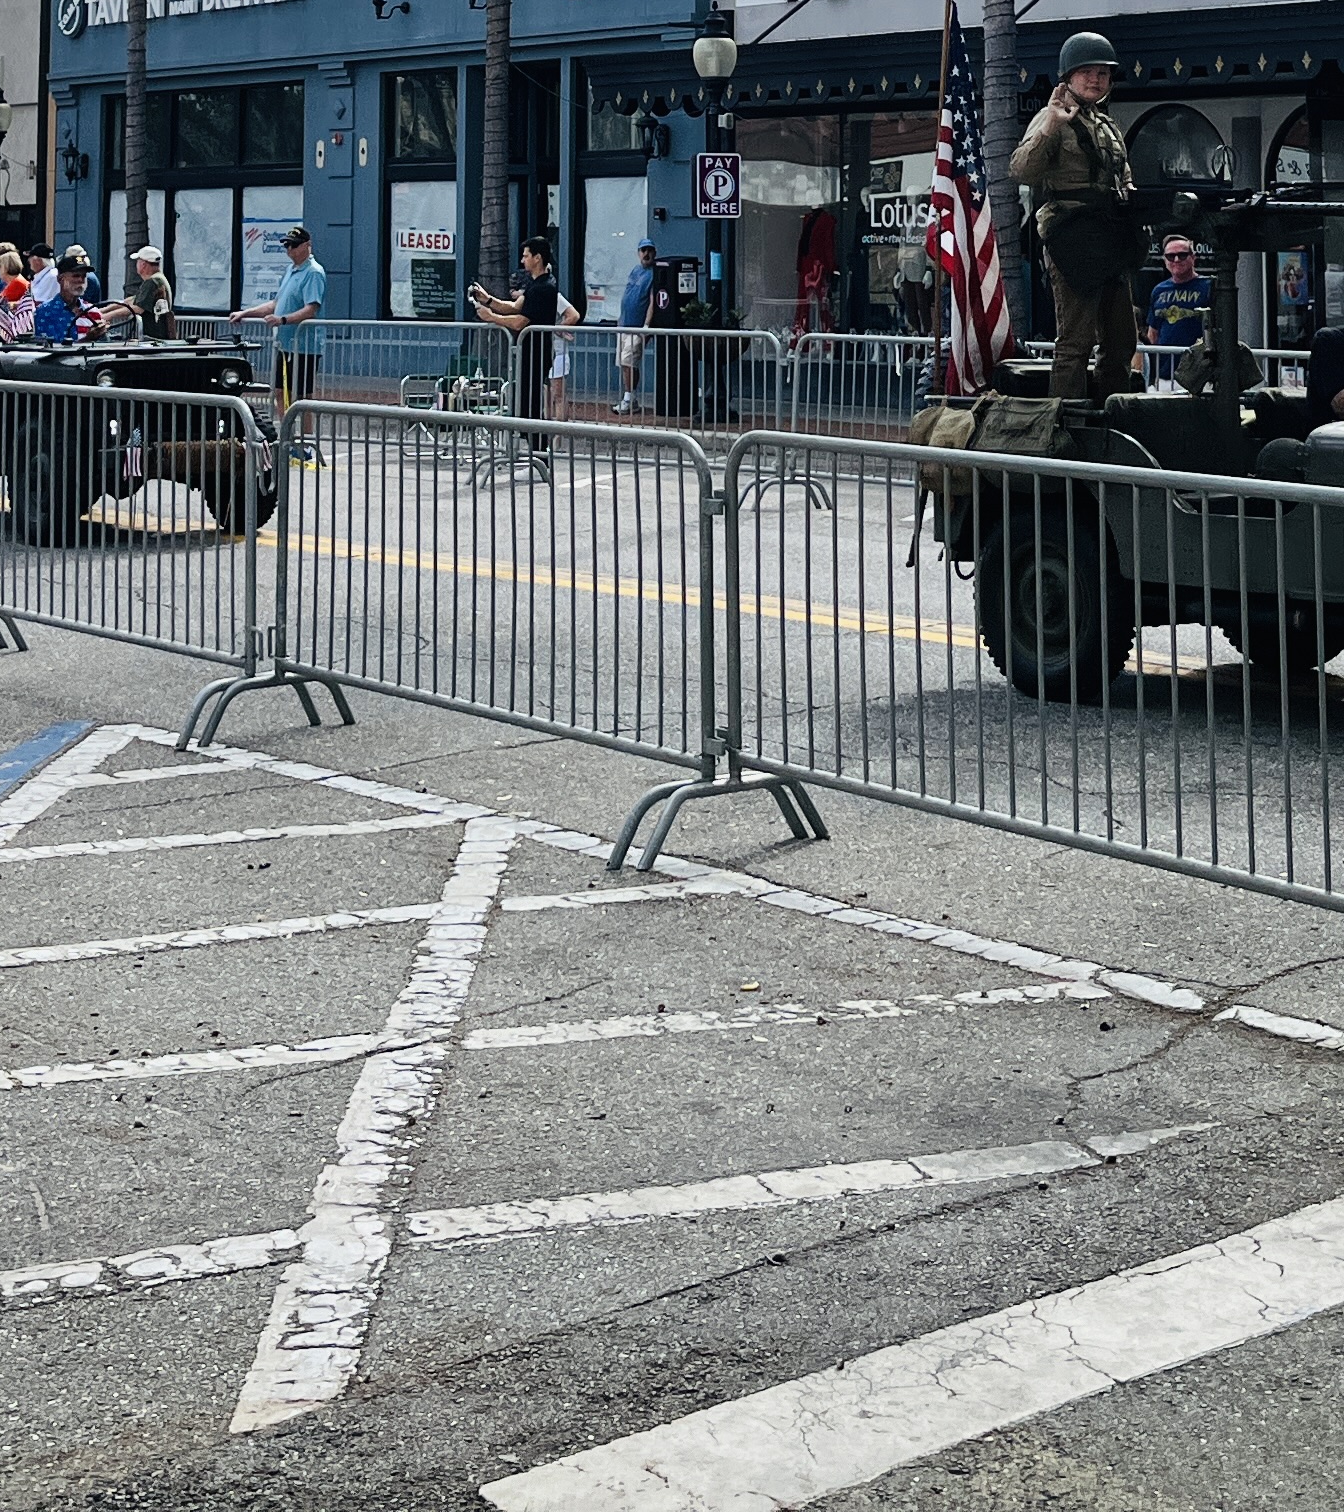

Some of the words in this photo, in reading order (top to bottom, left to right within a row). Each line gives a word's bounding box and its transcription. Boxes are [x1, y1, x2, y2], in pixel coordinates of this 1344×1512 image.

[168, 0, 198, 16] MAIN
[706, 158, 733, 169] PAY
[712, 175, 728, 197] P
[701, 203, 738, 214] HERE
[869, 197, 929, 228] Lotus
[400, 231, 451, 250] LEASED
[659, 291, 668, 306] P
[1171, 289, 1201, 303] NAVY
